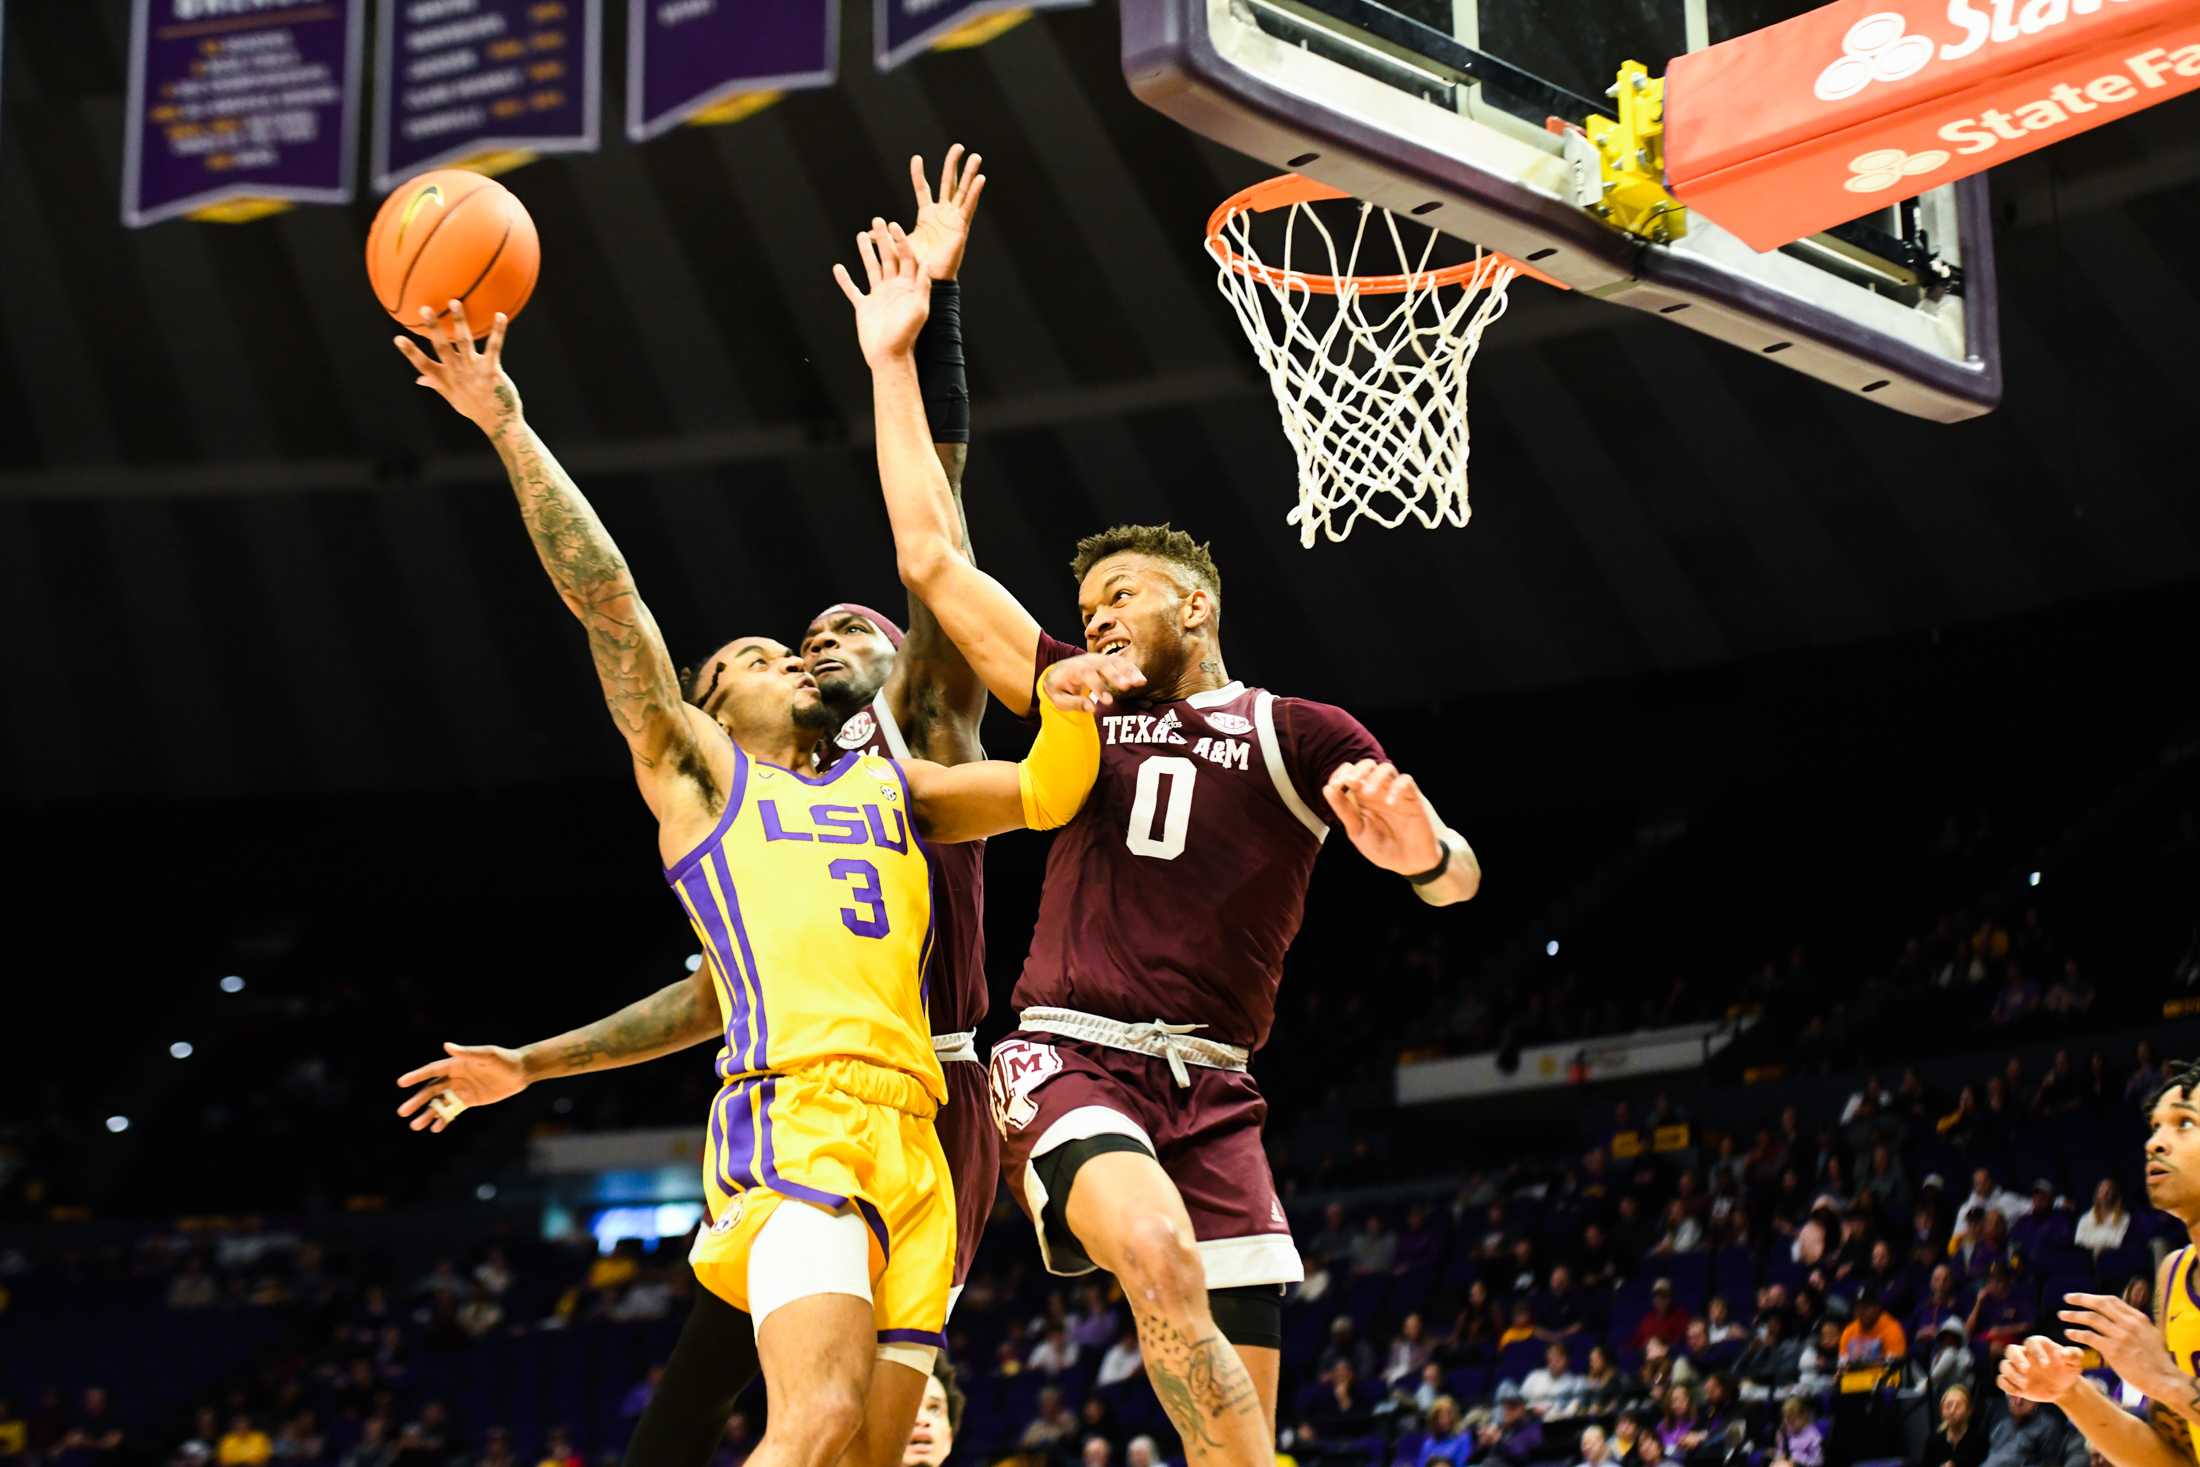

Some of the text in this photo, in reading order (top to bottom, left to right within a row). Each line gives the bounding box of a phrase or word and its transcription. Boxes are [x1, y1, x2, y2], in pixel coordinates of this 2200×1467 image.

[1192, 736, 1251, 771] A&M
[757, 799, 908, 856] LSU
[1126, 755, 1198, 861] 0
[828, 858, 890, 940] 3
